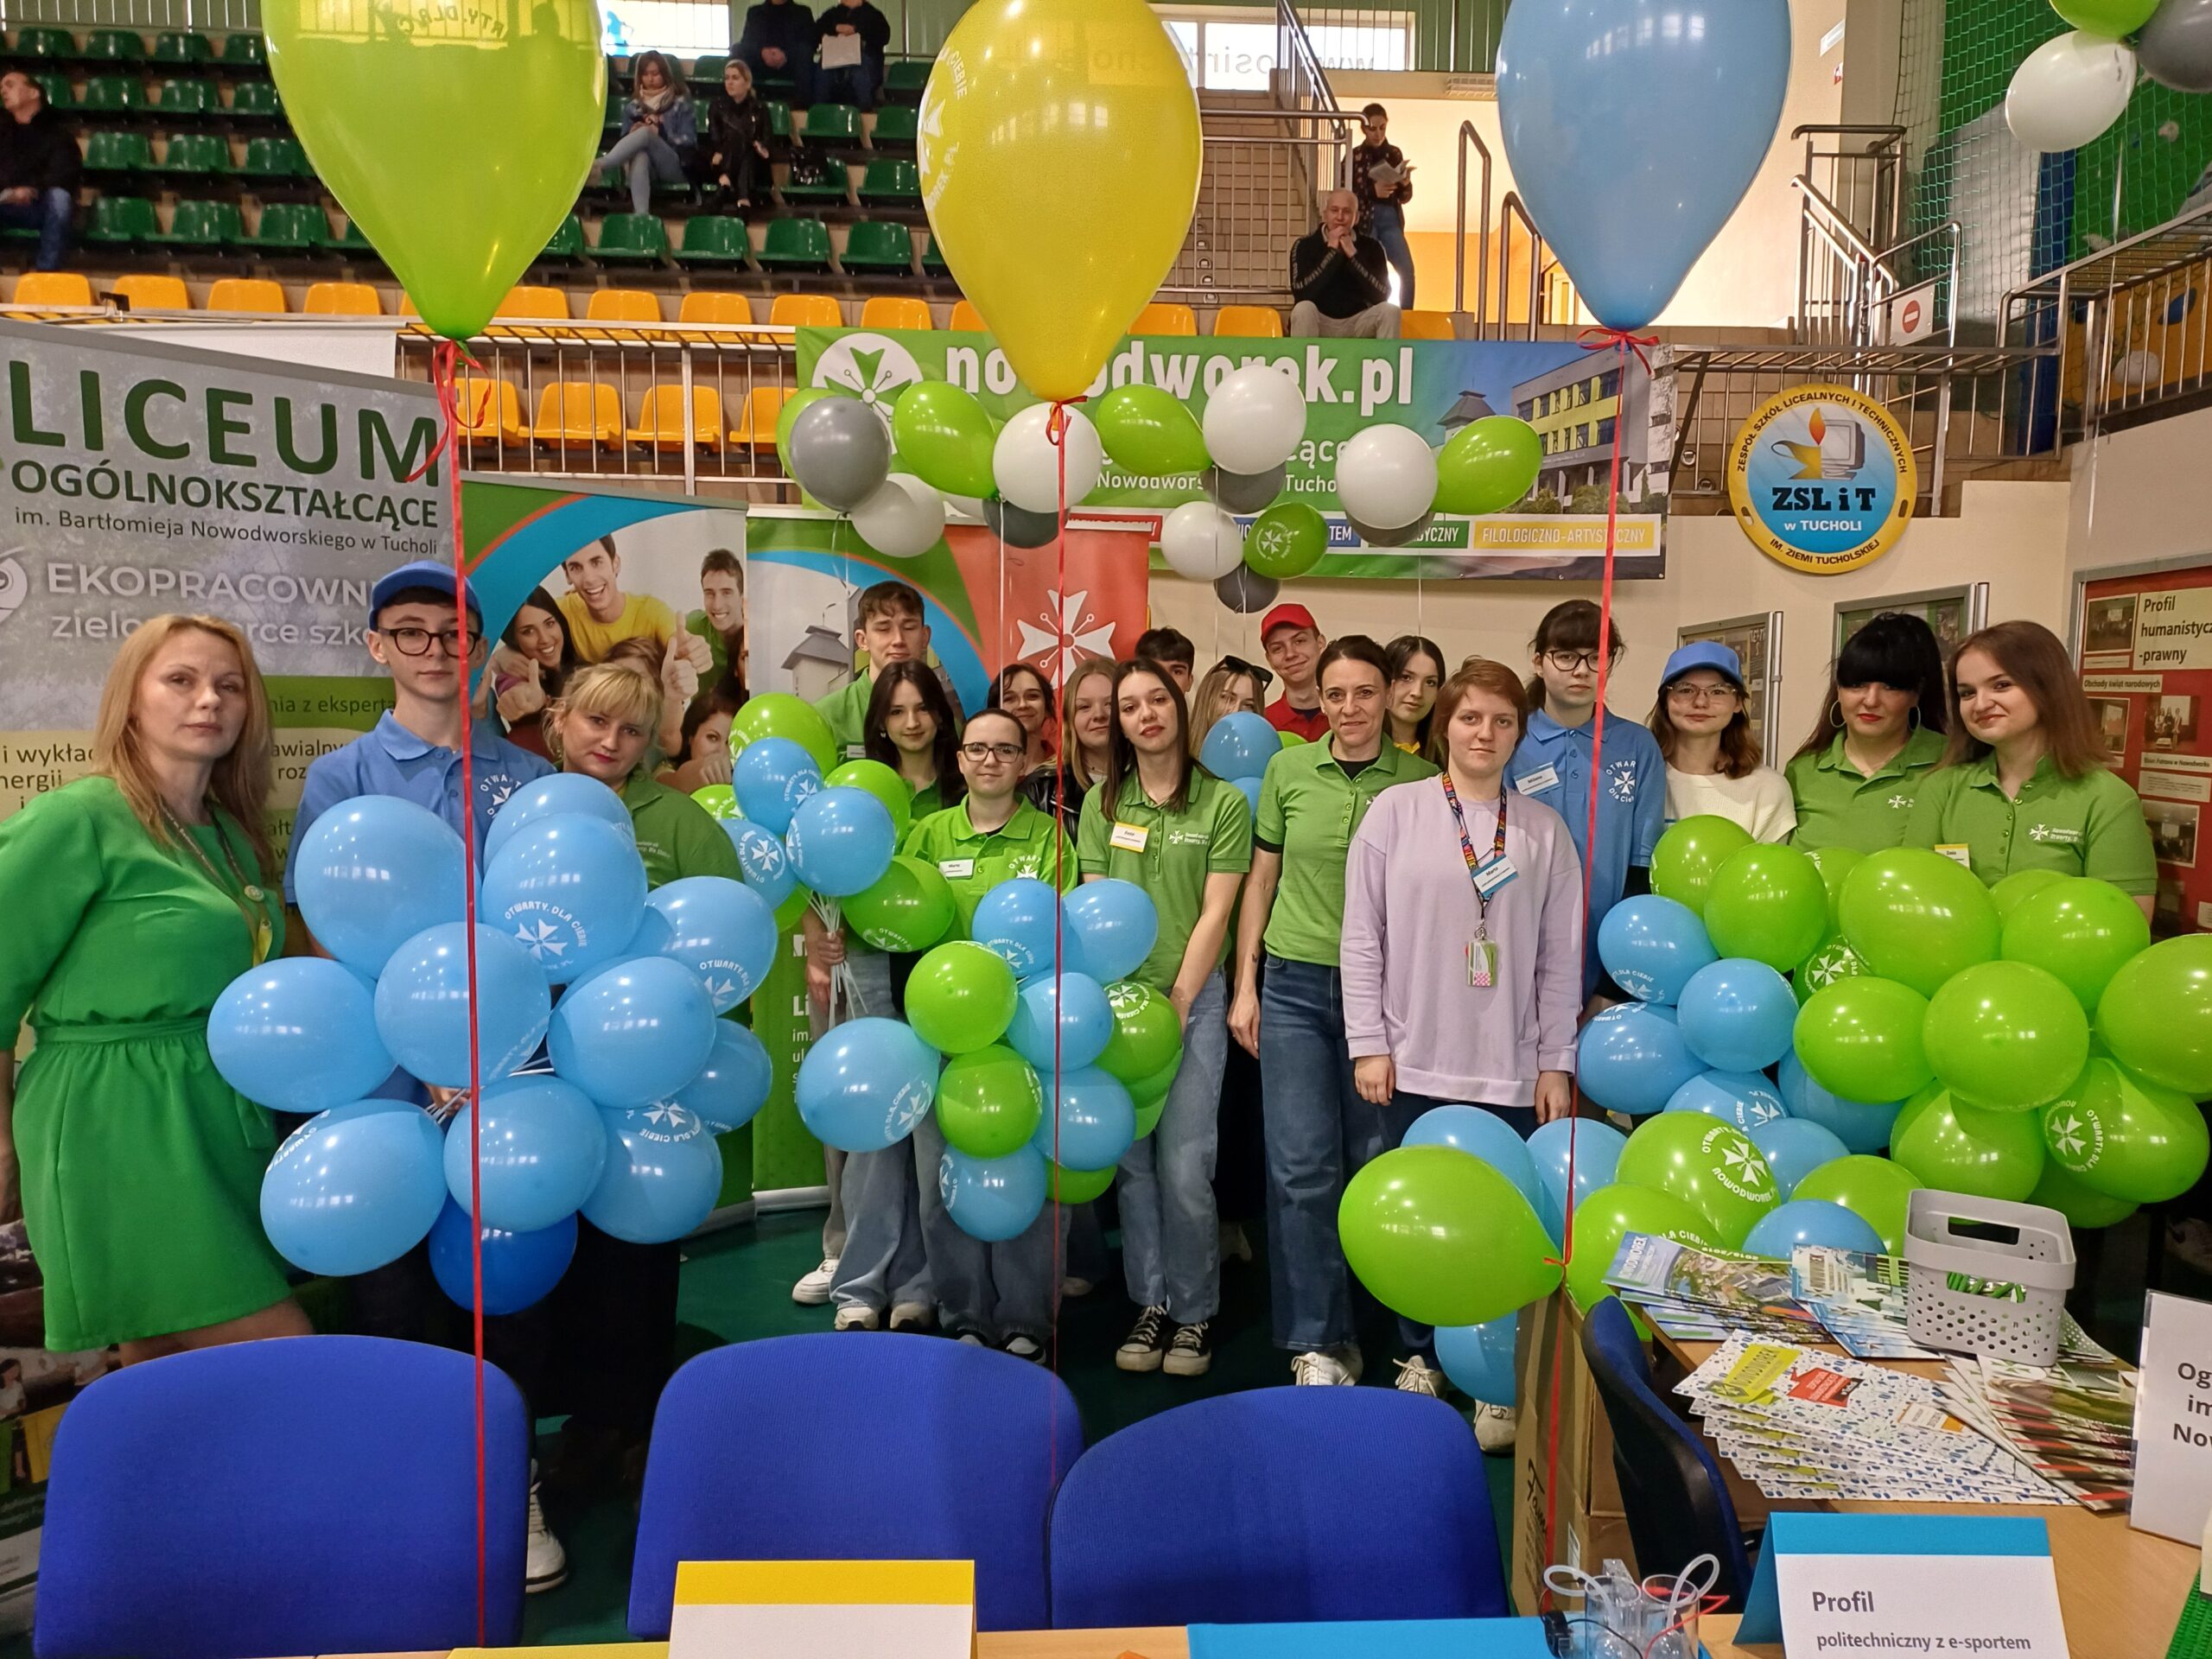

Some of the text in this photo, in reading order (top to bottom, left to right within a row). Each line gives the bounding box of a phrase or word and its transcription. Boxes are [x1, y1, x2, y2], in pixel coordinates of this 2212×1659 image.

[9, 359, 439, 487] LICEUM
[1737, 430, 1758, 473] ZESPÓŁ
[1753, 404, 1783, 432] SZKÓŁ
[1783, 391, 1850, 409] LICEALNYCH
[1858, 402, 1908, 474] TECHNICZNYCH
[1285, 474, 1337, 493] Tucho
[10, 459, 438, 531] OGÓLNOKSZTAŁCĄCE
[1772, 486, 1876, 512] ZSL i T
[16, 506, 438, 555] im. Bartłomieja Nowodworskiego w Tucholi
[1483, 526, 1646, 543] FILOLOGICZNO-ARTYSTCZNY
[1783, 520, 1862, 531] w TUCHOLI
[1770, 537, 1880, 565] IM. ZIEMI TUCHOLSKIEJ
[47, 562, 372, 607] EKOPRACOWN
[2143, 595, 2176, 613] Profil
[2140, 620, 2212, 639] humanistycz
[2139, 648, 2187, 665] -prawny
[2083, 678, 2108, 690] Obchody
[2124, 677, 2161, 690] narodowych
[303, 699, 312, 712] z
[1605, 760, 1637, 776] OTWAR
[0, 769, 62, 792] nergii
[1008, 854, 1042, 870] OTWART
[505, 900, 588, 948] OTWARTY. DLA CIEBIE
[699, 959, 742, 977] OTWARTY.
[1812, 1591, 1874, 1612] Profil
[1816, 1631, 2031, 1654] politechniczny z e-sportem
